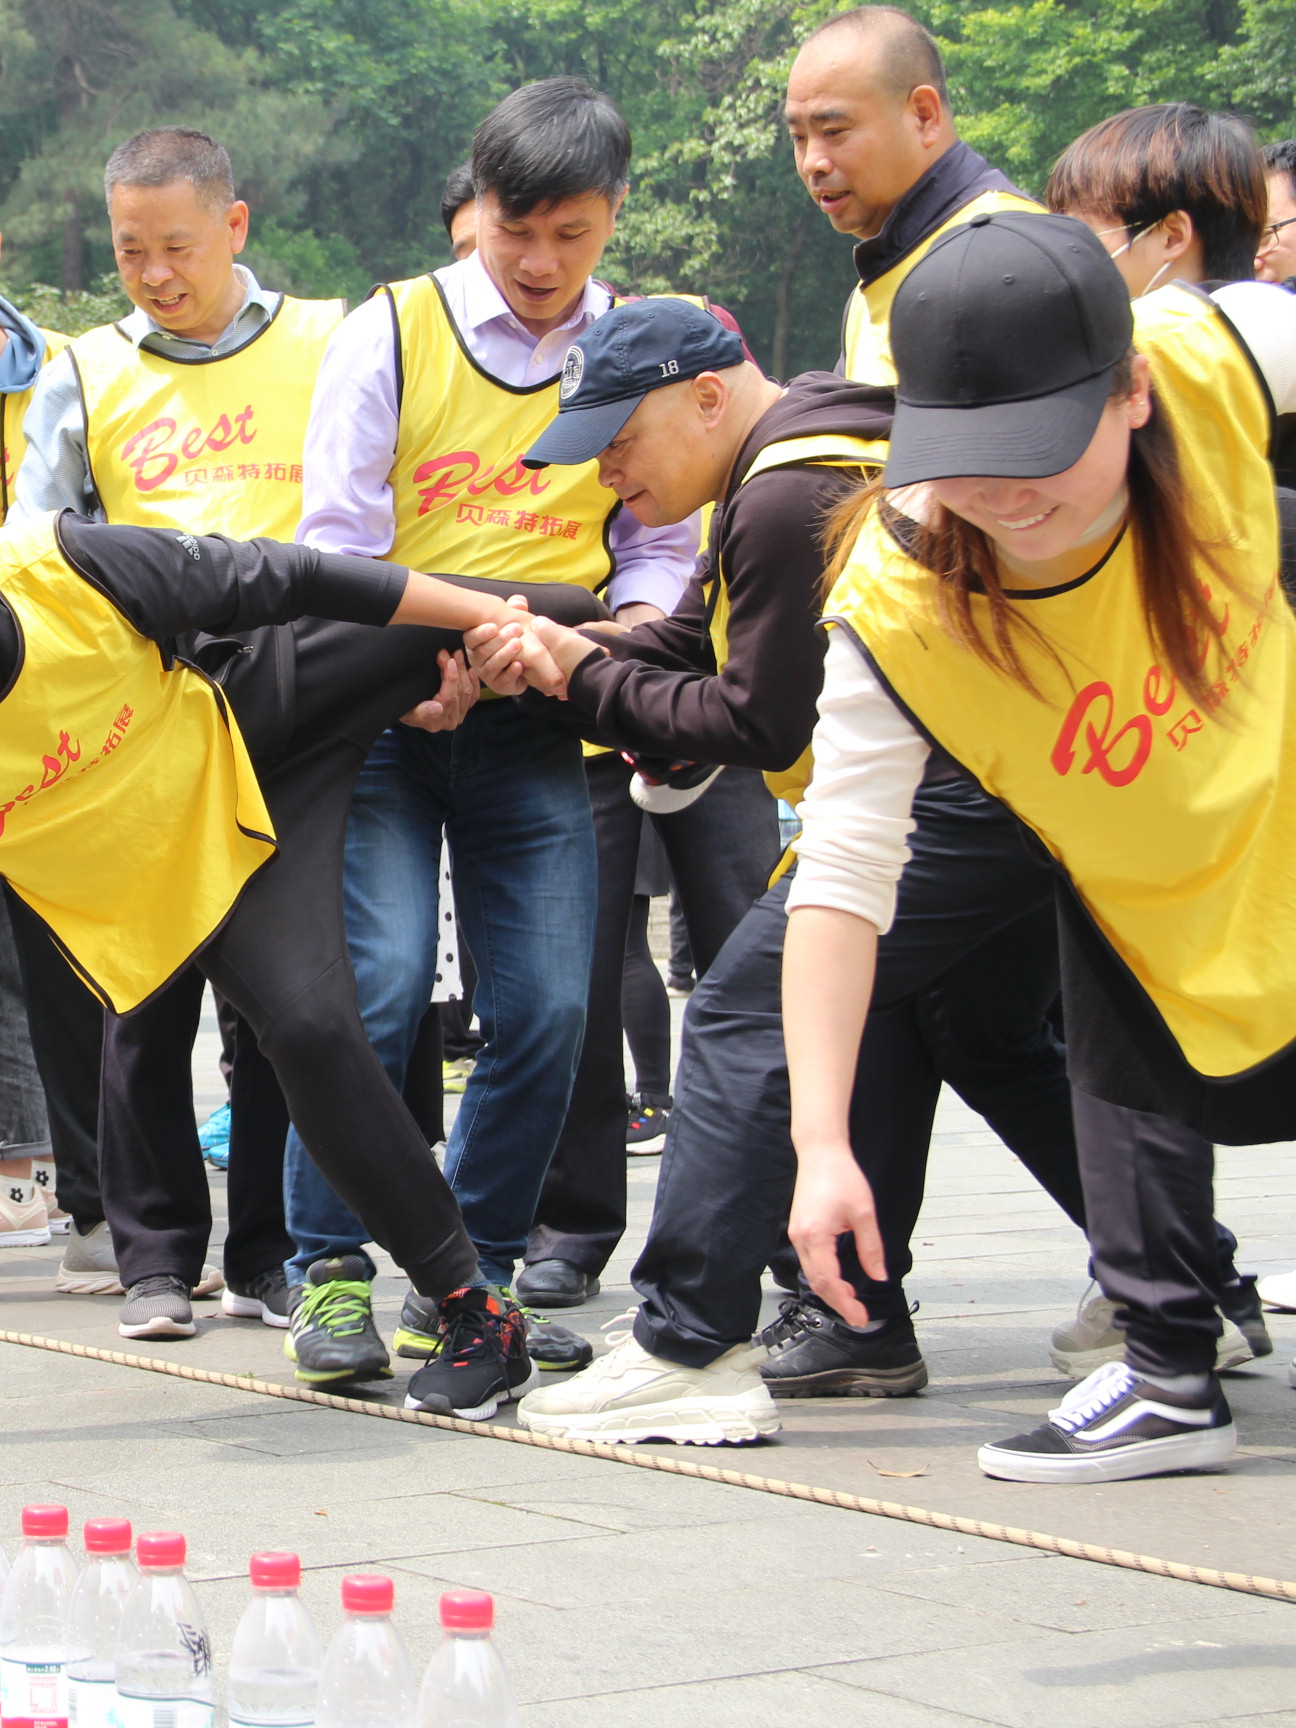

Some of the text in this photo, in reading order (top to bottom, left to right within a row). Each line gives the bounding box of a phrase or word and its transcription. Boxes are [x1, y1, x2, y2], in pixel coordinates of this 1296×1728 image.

[658, 359, 680, 378] 18
[120, 405, 258, 492] Best
[184, 462, 303, 487] 贝森特拓展
[455, 503, 583, 540] 贝森特拓展
